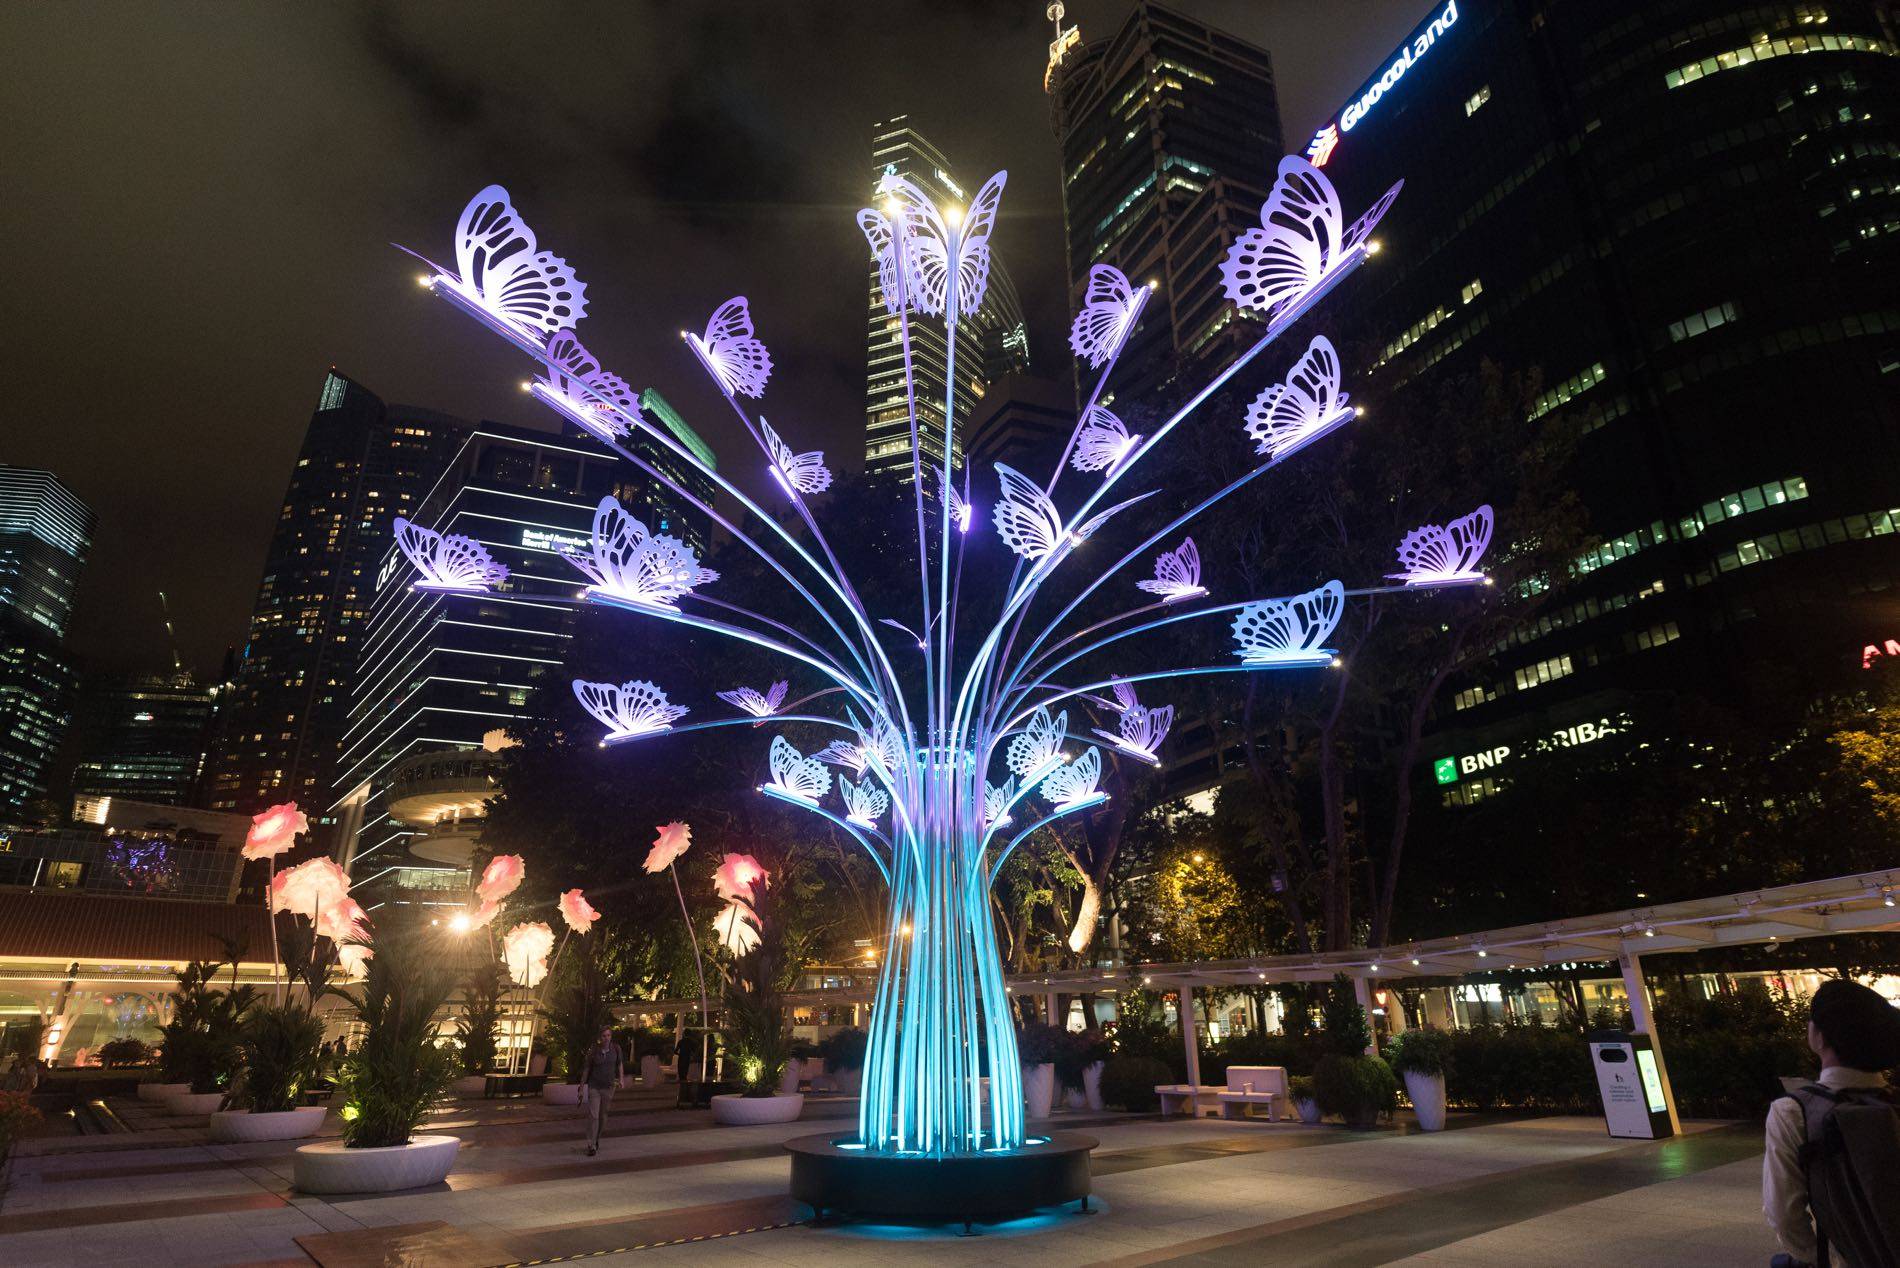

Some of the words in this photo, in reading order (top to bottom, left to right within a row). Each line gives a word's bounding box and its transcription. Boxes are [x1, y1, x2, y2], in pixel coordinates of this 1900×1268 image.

[1341, 0, 1458, 132] GuocoLand
[523, 529, 545, 541] Bank
[544, 533, 554, 542] of
[553, 534, 587, 547] America
[376, 548, 400, 591] OUE
[1461, 746, 1511, 774] BNP
